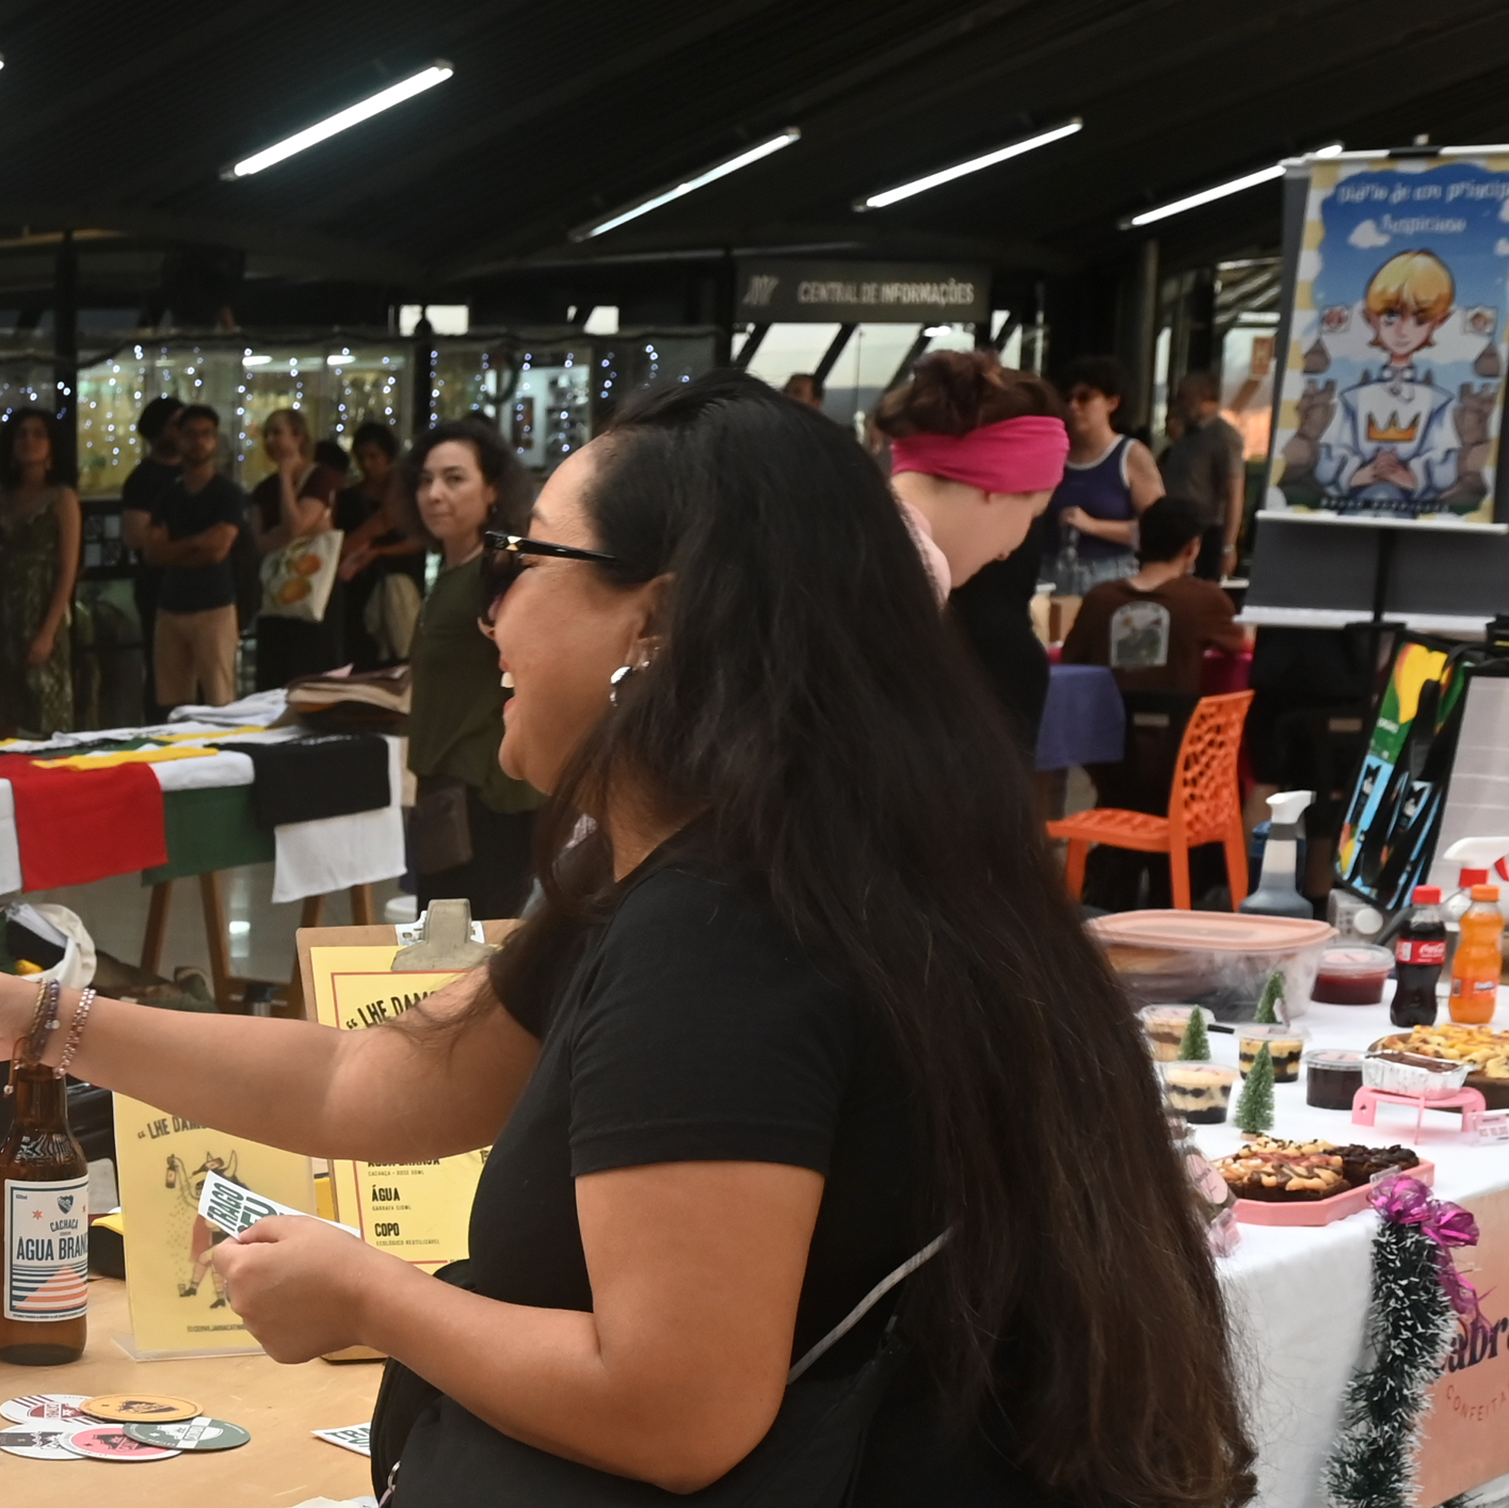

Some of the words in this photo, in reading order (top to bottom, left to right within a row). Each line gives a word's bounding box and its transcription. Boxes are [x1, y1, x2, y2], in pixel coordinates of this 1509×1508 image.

[798, 280, 860, 303] CENTRAL
[862, 281, 879, 303] DE
[881, 277, 975, 309] INFORMAÇÕES
[371, 1184, 401, 1202] ÁGUA
[206, 1182, 244, 1232] TRAGO
[374, 1222, 400, 1237] COPO
[15, 1236, 55, 1261] ÁGUA
